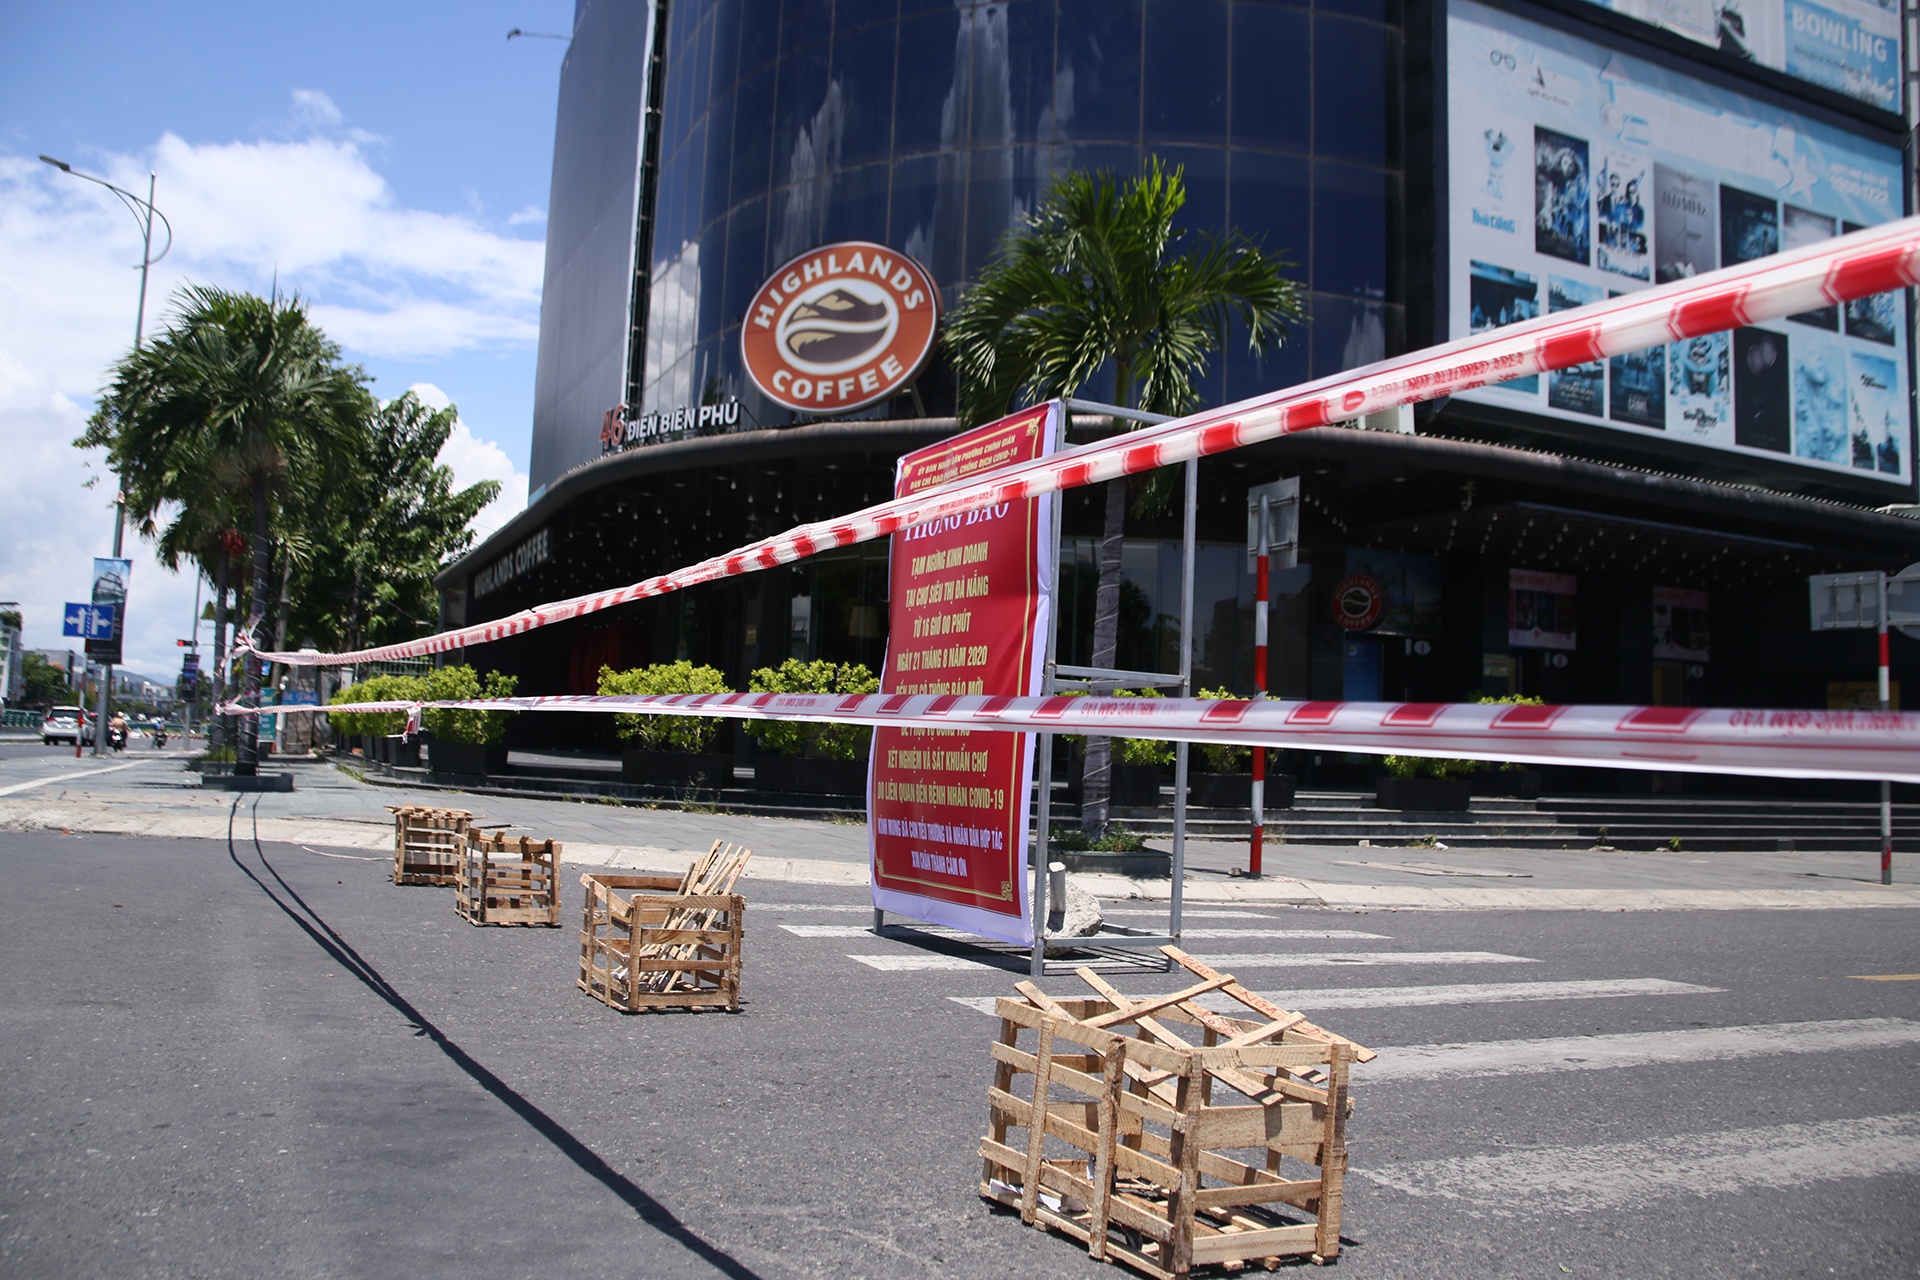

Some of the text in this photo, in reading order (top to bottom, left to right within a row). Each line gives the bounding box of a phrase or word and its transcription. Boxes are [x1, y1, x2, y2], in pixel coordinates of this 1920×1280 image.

[1792, 5, 1888, 64] BOWLING
[753, 250, 926, 330] HIGHLANDS
[771, 353, 905, 403] COFFEE
[600, 404, 626, 450] 46
[660, 404, 695, 433] BIÊN
[698, 395, 740, 428] PHỦ
[910, 479, 922, 490] BAN
[993, 446, 1018, 463] COVID-19
[925, 463, 938, 474] BAN
[961, 446, 984, 462] PHƯỜNG
[984, 440, 1002, 454] CHÍNH
[514, 527, 549, 576] COFFEE
[911, 541, 989, 580] TẠM NGỪNG KINH DOANH
[906, 588, 917, 611] TẠI
[916, 584, 930, 609] CHỢ
[929, 580, 944, 604] SIÊU
[944, 581, 955, 605] THỊ
[955, 574, 965, 600] ĐÀ
[913, 608, 972, 638] TỪ 16 GIỜ 00 PHÚT
[1337, 614, 1374, 629] COFFEE
[897, 643, 988, 672] NGÀY 21 THÁNG 8 NĂM 2020
[929, 678, 950, 695] THÔNG
[951, 677, 966, 696] BÁO
[887, 743, 989, 777] XÉT NGHIỆM VÀ SÁT KHUẨN CHỢ
[878, 778, 1004, 810] DO LIÊN QUAN ĐẾN BỆNH NHÂN COVID-19
[901, 816, 909, 838] BÀ
[953, 823, 969, 846] NHÂN
[980, 827, 991, 853] HỢP
[991, 826, 1003, 851] TÁC
